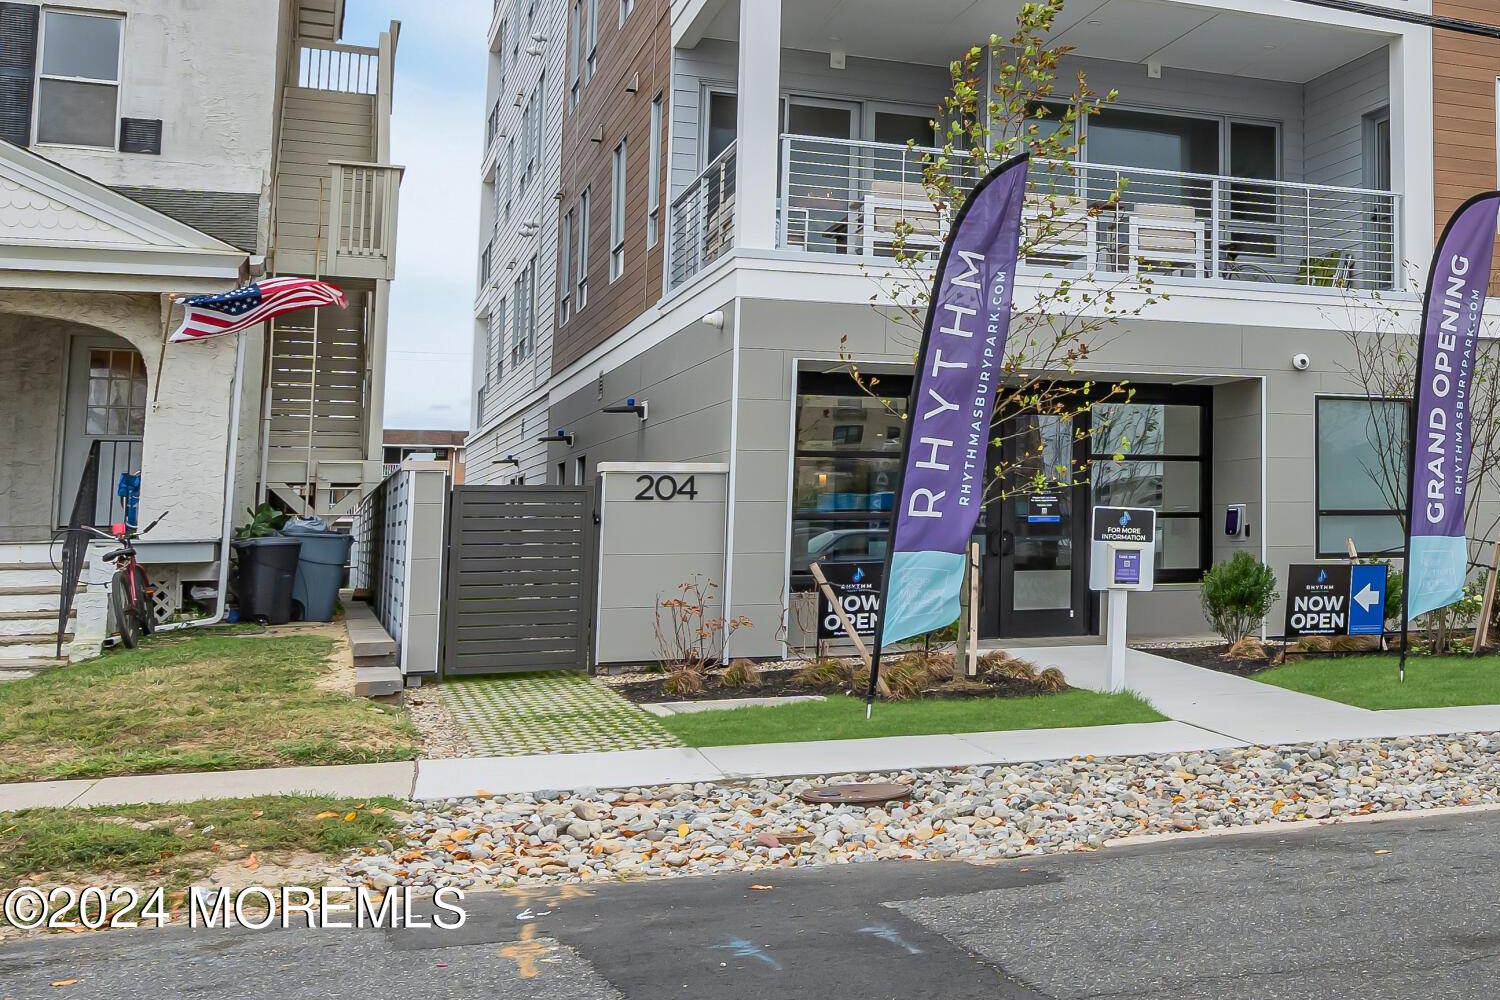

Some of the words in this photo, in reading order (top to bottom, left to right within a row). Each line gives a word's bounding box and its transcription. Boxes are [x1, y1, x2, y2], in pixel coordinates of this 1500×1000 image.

[908, 250, 985, 518] RHYTHM
[1432, 254, 1469, 398] OPENING
[958, 271, 1007, 506] RHYTHMASBURYPARK.COM
[1454, 289, 1480, 495] RHYTHMASBURYPARK.COM
[635, 475, 698, 500] 204
[1426, 407, 1448, 524] GRAND
[1101, 533, 1146, 541] INFORMATION
[1290, 612, 1345, 629] OPEN
[1294, 595, 1344, 611] NOW
